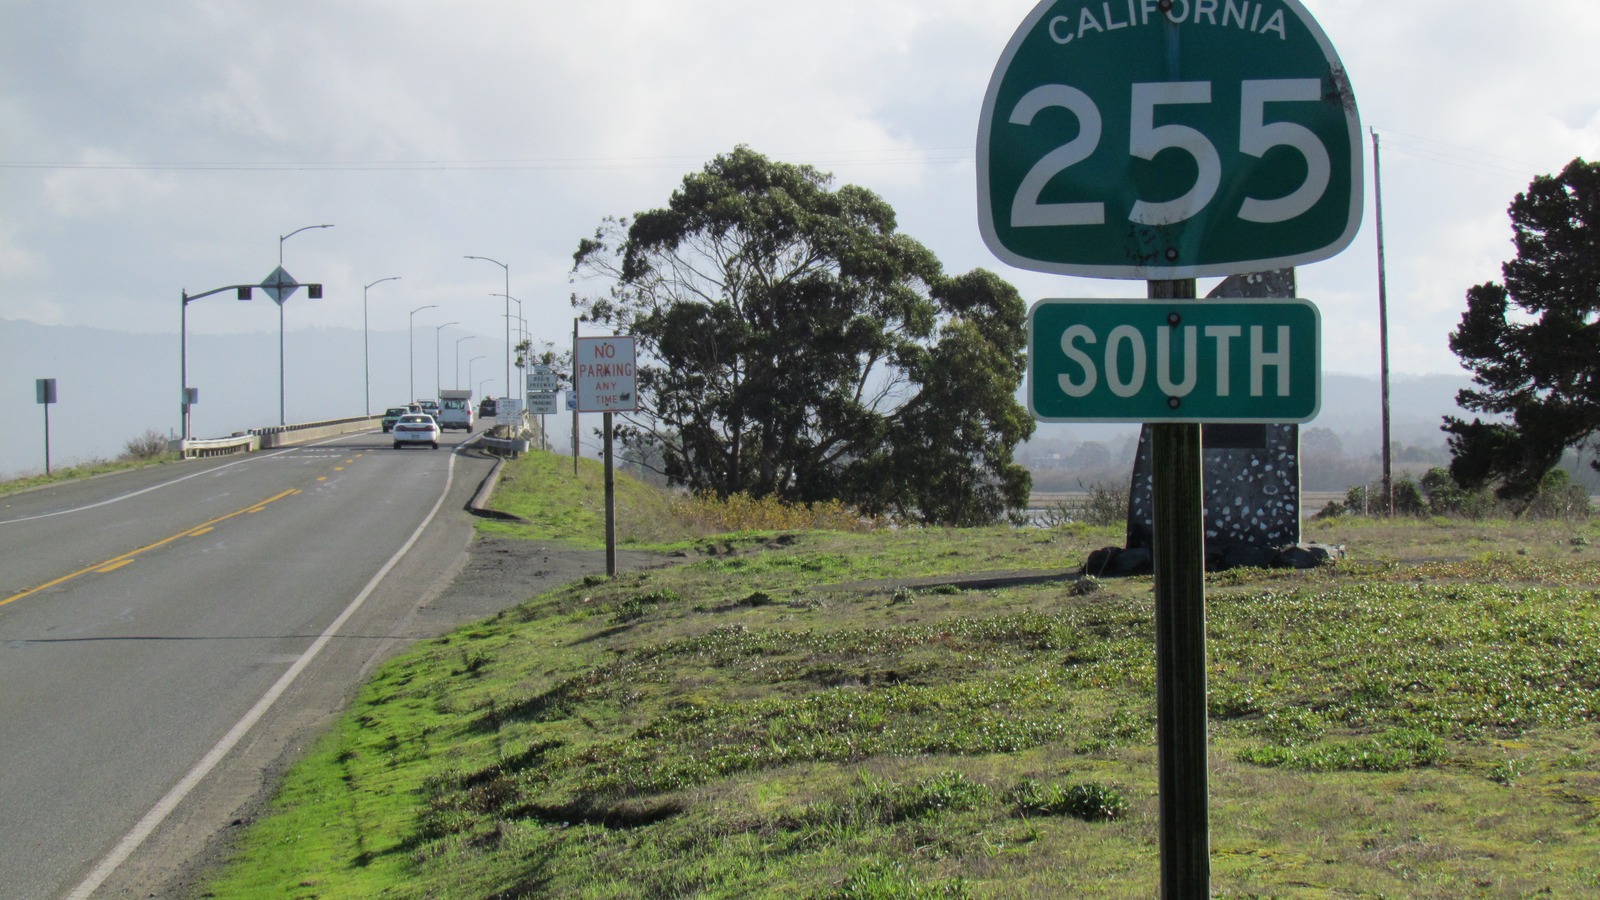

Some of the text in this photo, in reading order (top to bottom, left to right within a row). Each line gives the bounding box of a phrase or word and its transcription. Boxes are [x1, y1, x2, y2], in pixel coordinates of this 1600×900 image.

[1048, 0, 1287, 45] CALIFORNIA
[1008, 78, 1331, 227] 255
[595, 344, 616, 359] NO
[1058, 324, 1291, 398] SOUTH
[579, 363, 632, 378] PARKING
[595, 381, 618, 391] ANY
[595, 394, 618, 404] TIME
